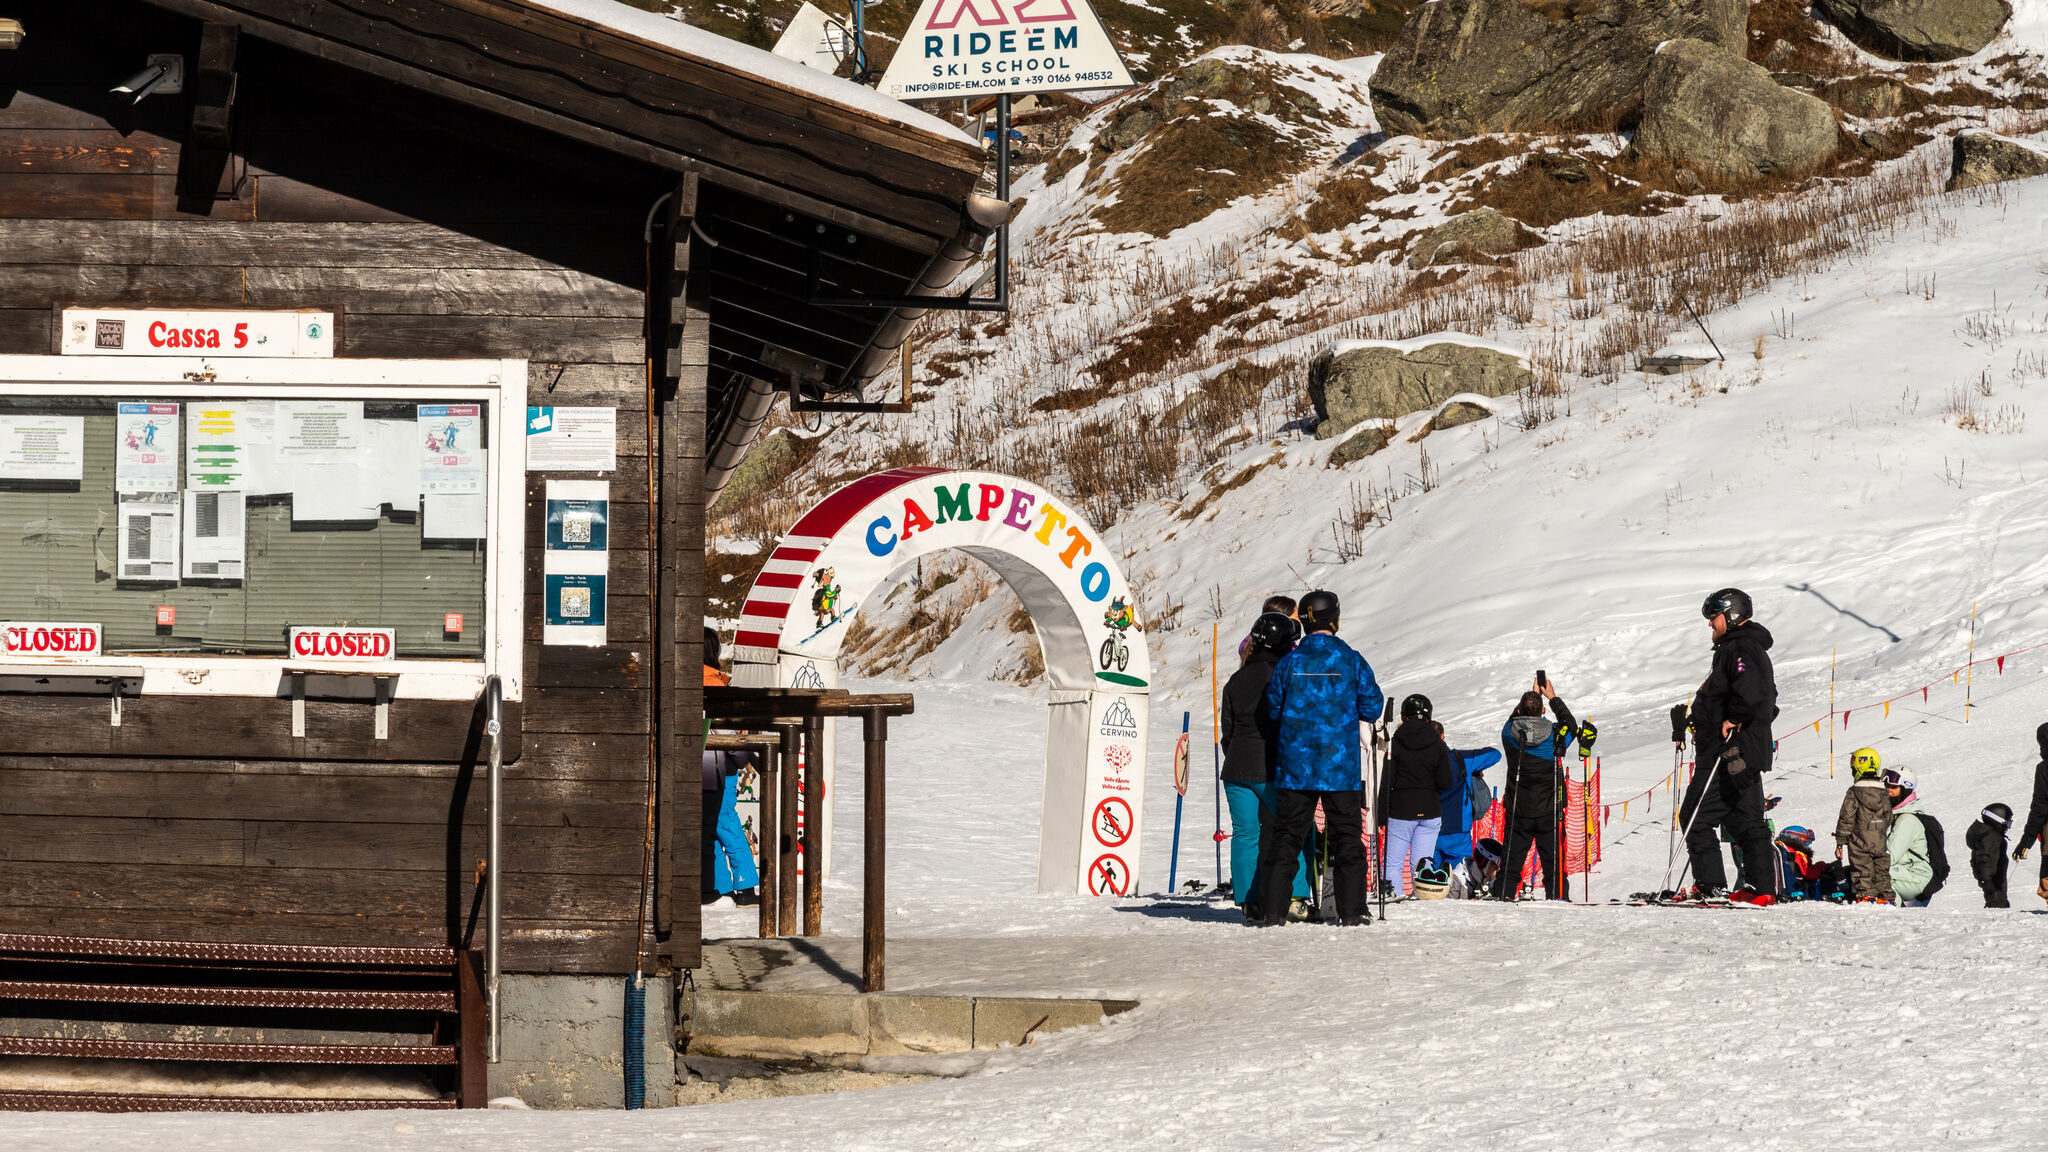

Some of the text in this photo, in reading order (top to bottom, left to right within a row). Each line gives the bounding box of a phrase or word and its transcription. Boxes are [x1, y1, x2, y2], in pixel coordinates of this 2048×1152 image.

[932, 56, 1070, 77] SKI SCHOOL
[905, 71, 1113, 93] INFO@RIDE-EM.COM +39 0166 948532
[148, 320, 249, 348] Cassa 5
[865, 483, 1111, 602] CAMPETTO
[6, 627, 98, 652] CLOSED
[294, 631, 391, 657] CLOSED
[1100, 728, 1138, 739] CERVINO
